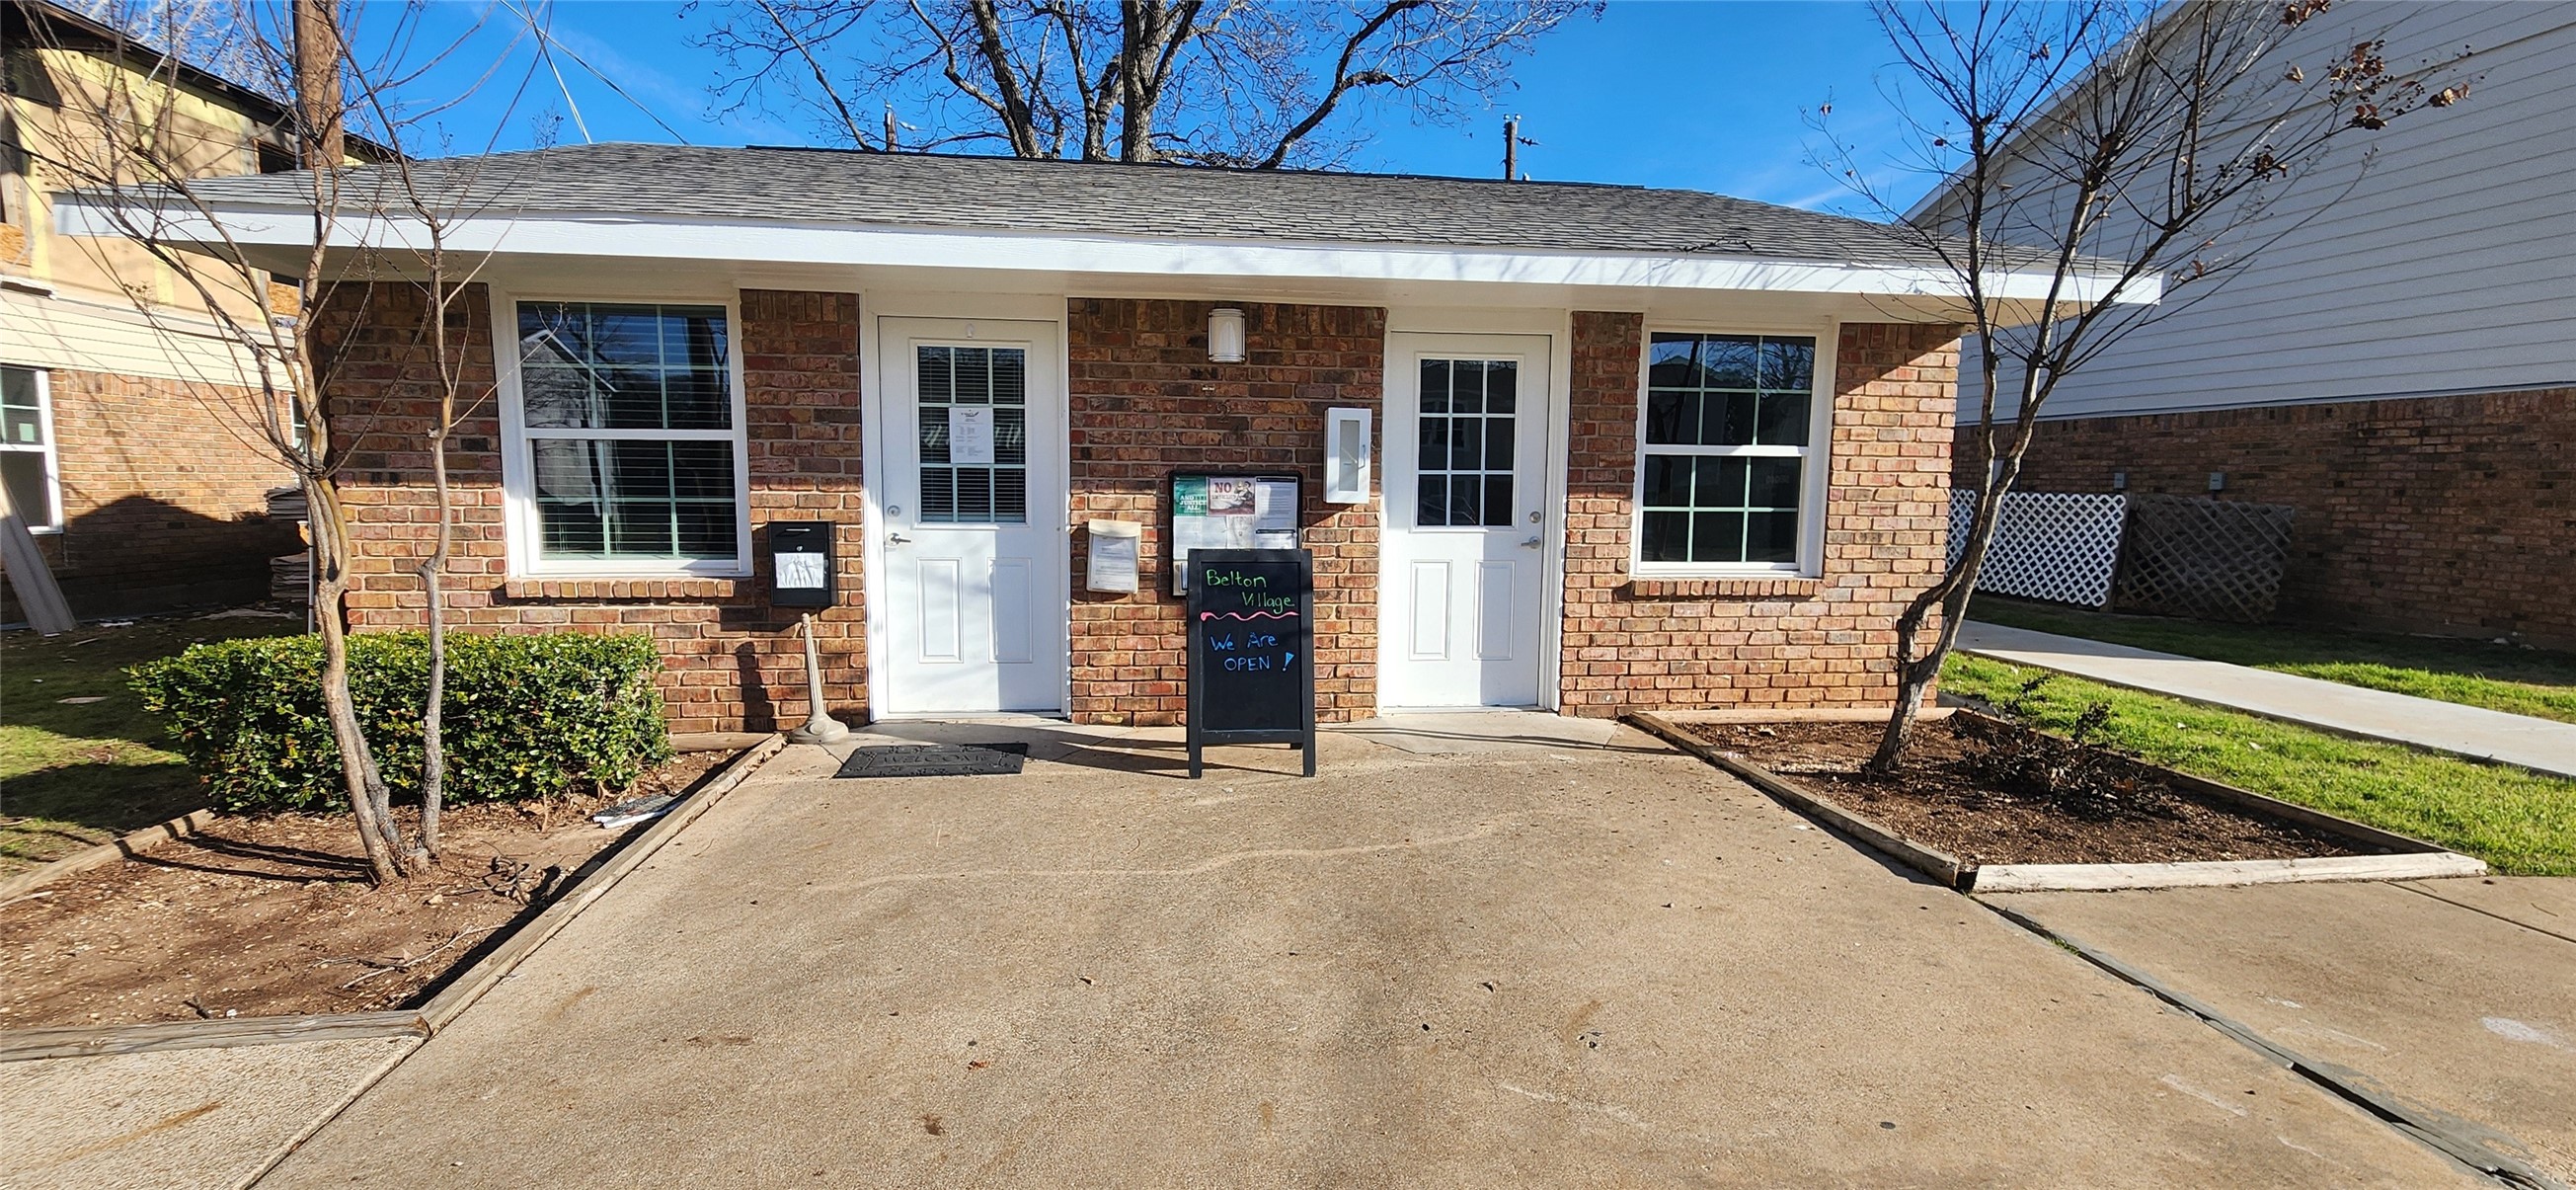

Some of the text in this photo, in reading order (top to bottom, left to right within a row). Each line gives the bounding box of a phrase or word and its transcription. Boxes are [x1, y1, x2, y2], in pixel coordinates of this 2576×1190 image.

[1214, 482, 1232, 493] NO
[1206, 569, 1267, 588] Belton
[1242, 592, 1295, 614] Village
[1210, 632, 1279, 651] We Are
[1224, 656, 1271, 672] OPEN
[881, 754, 989, 764] WELCOME
